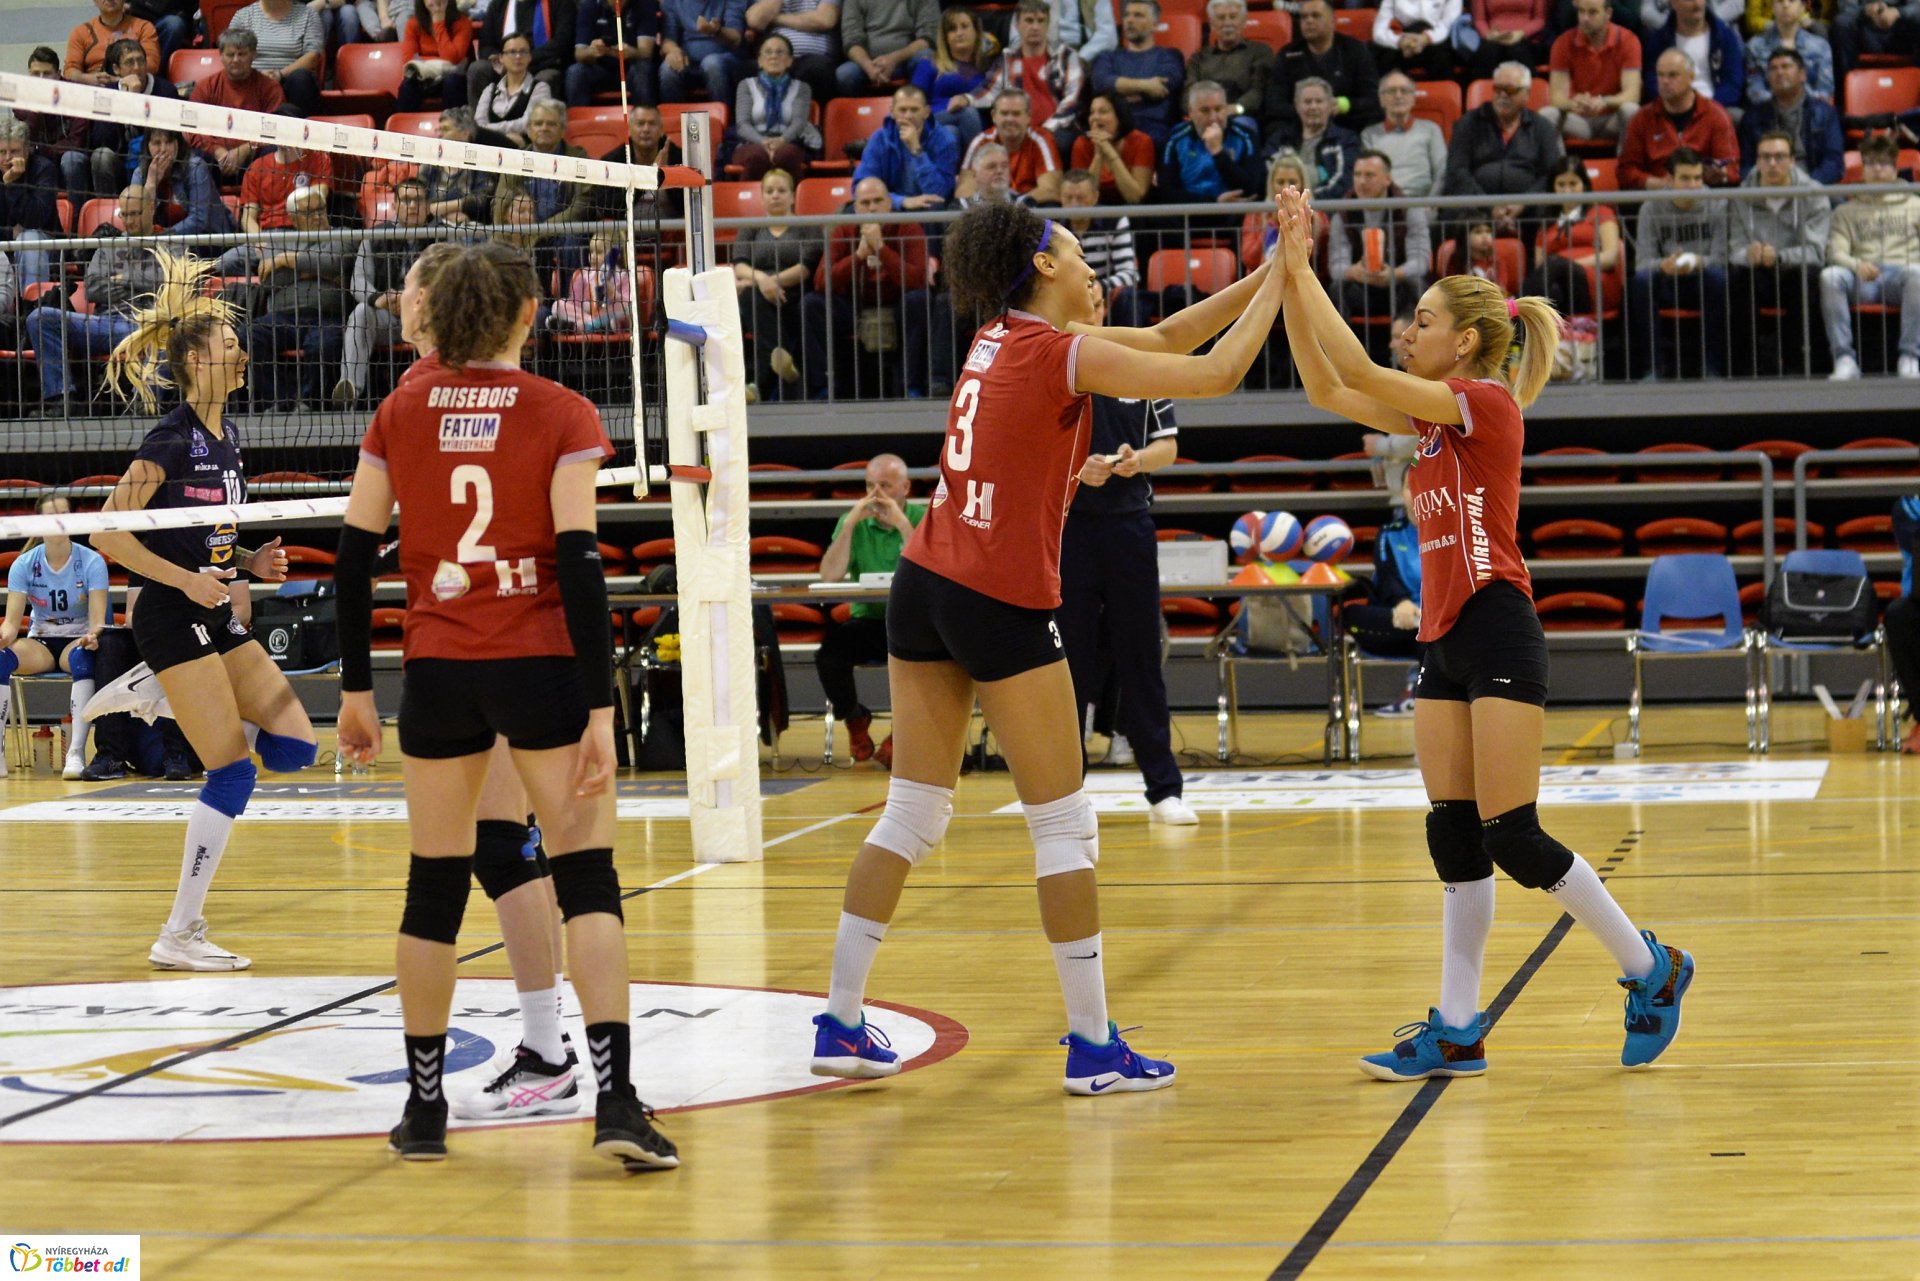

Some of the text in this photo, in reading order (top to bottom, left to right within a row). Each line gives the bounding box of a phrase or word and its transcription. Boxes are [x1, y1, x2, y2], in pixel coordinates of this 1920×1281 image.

[427, 386, 519, 409] BRISEBOIS
[442, 418, 497, 438] FATUM
[946, 378, 981, 472] 3
[450, 464, 497, 564] 2
[48, 590, 68, 612] 13
[1048, 620, 1062, 649] 3
